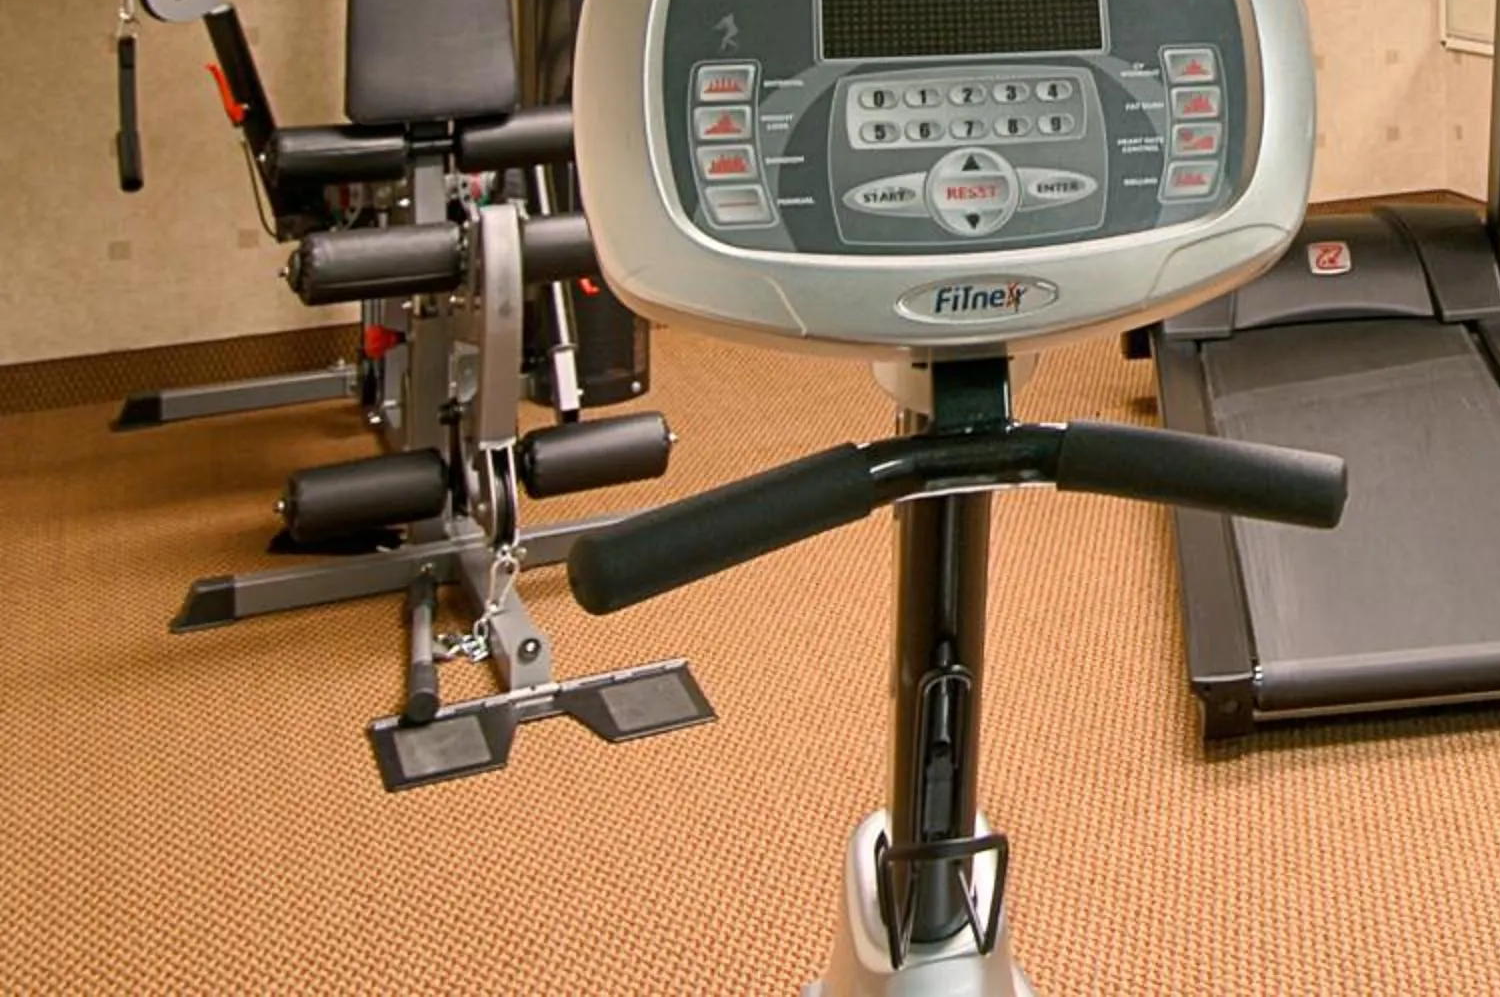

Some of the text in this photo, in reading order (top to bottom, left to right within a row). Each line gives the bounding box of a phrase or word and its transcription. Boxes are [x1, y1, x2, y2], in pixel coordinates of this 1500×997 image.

[874, 83, 1058, 108] 0 1 2 3 4
[874, 116, 1061, 141] 5 6 7 8 9
[863, 186, 907, 204] START
[946, 185, 998, 201] RESET
[1036, 180, 1080, 194] ENTER
